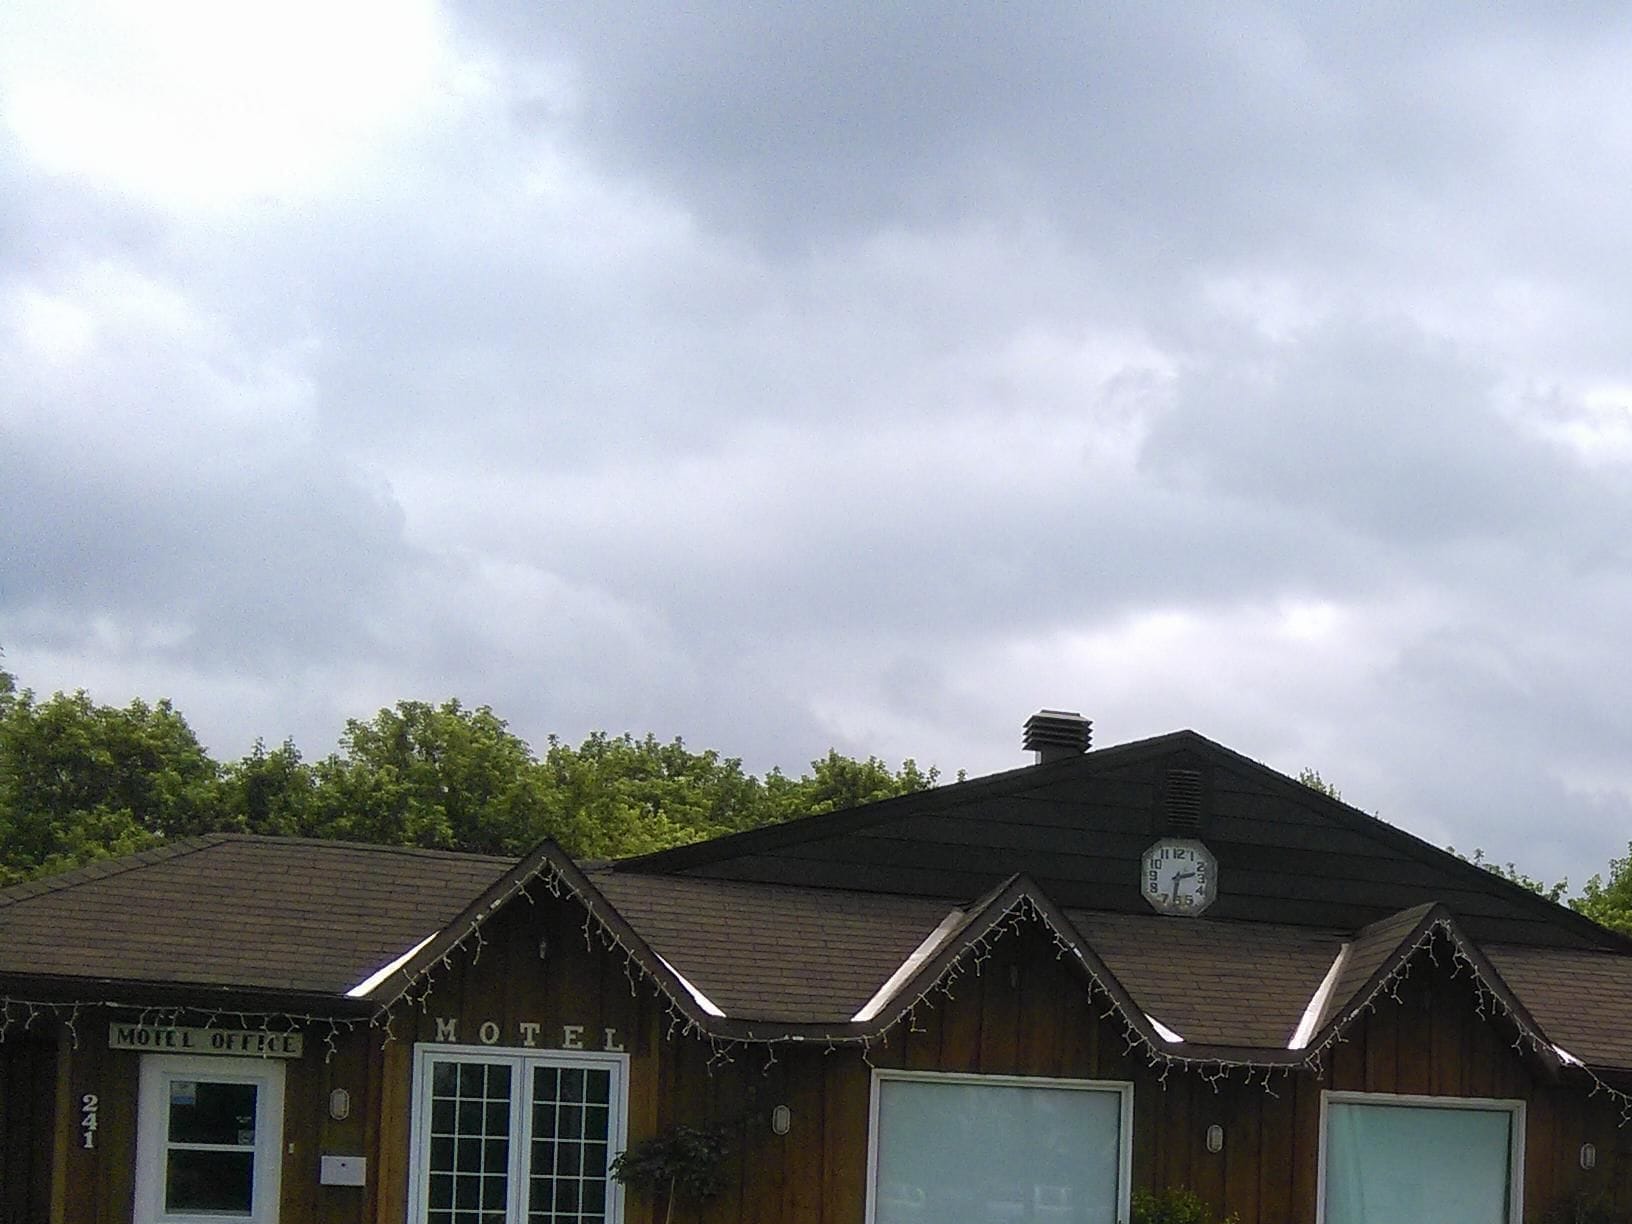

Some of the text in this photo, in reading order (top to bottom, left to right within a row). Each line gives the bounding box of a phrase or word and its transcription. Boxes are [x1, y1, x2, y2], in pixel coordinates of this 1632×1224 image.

[1160, 848, 1169, 859] 11
[1173, 848, 1185, 859] 12
[1150, 858, 1162, 869] 10
[1197, 862, 1206, 872] 2
[1149, 870, 1158, 881] 9
[1150, 882, 1158, 893] 8
[117, 1027, 297, 1053] MOTEL OFFICE
[435, 1018, 625, 1051] MOTEL
[81, 1094, 98, 1148] 241
